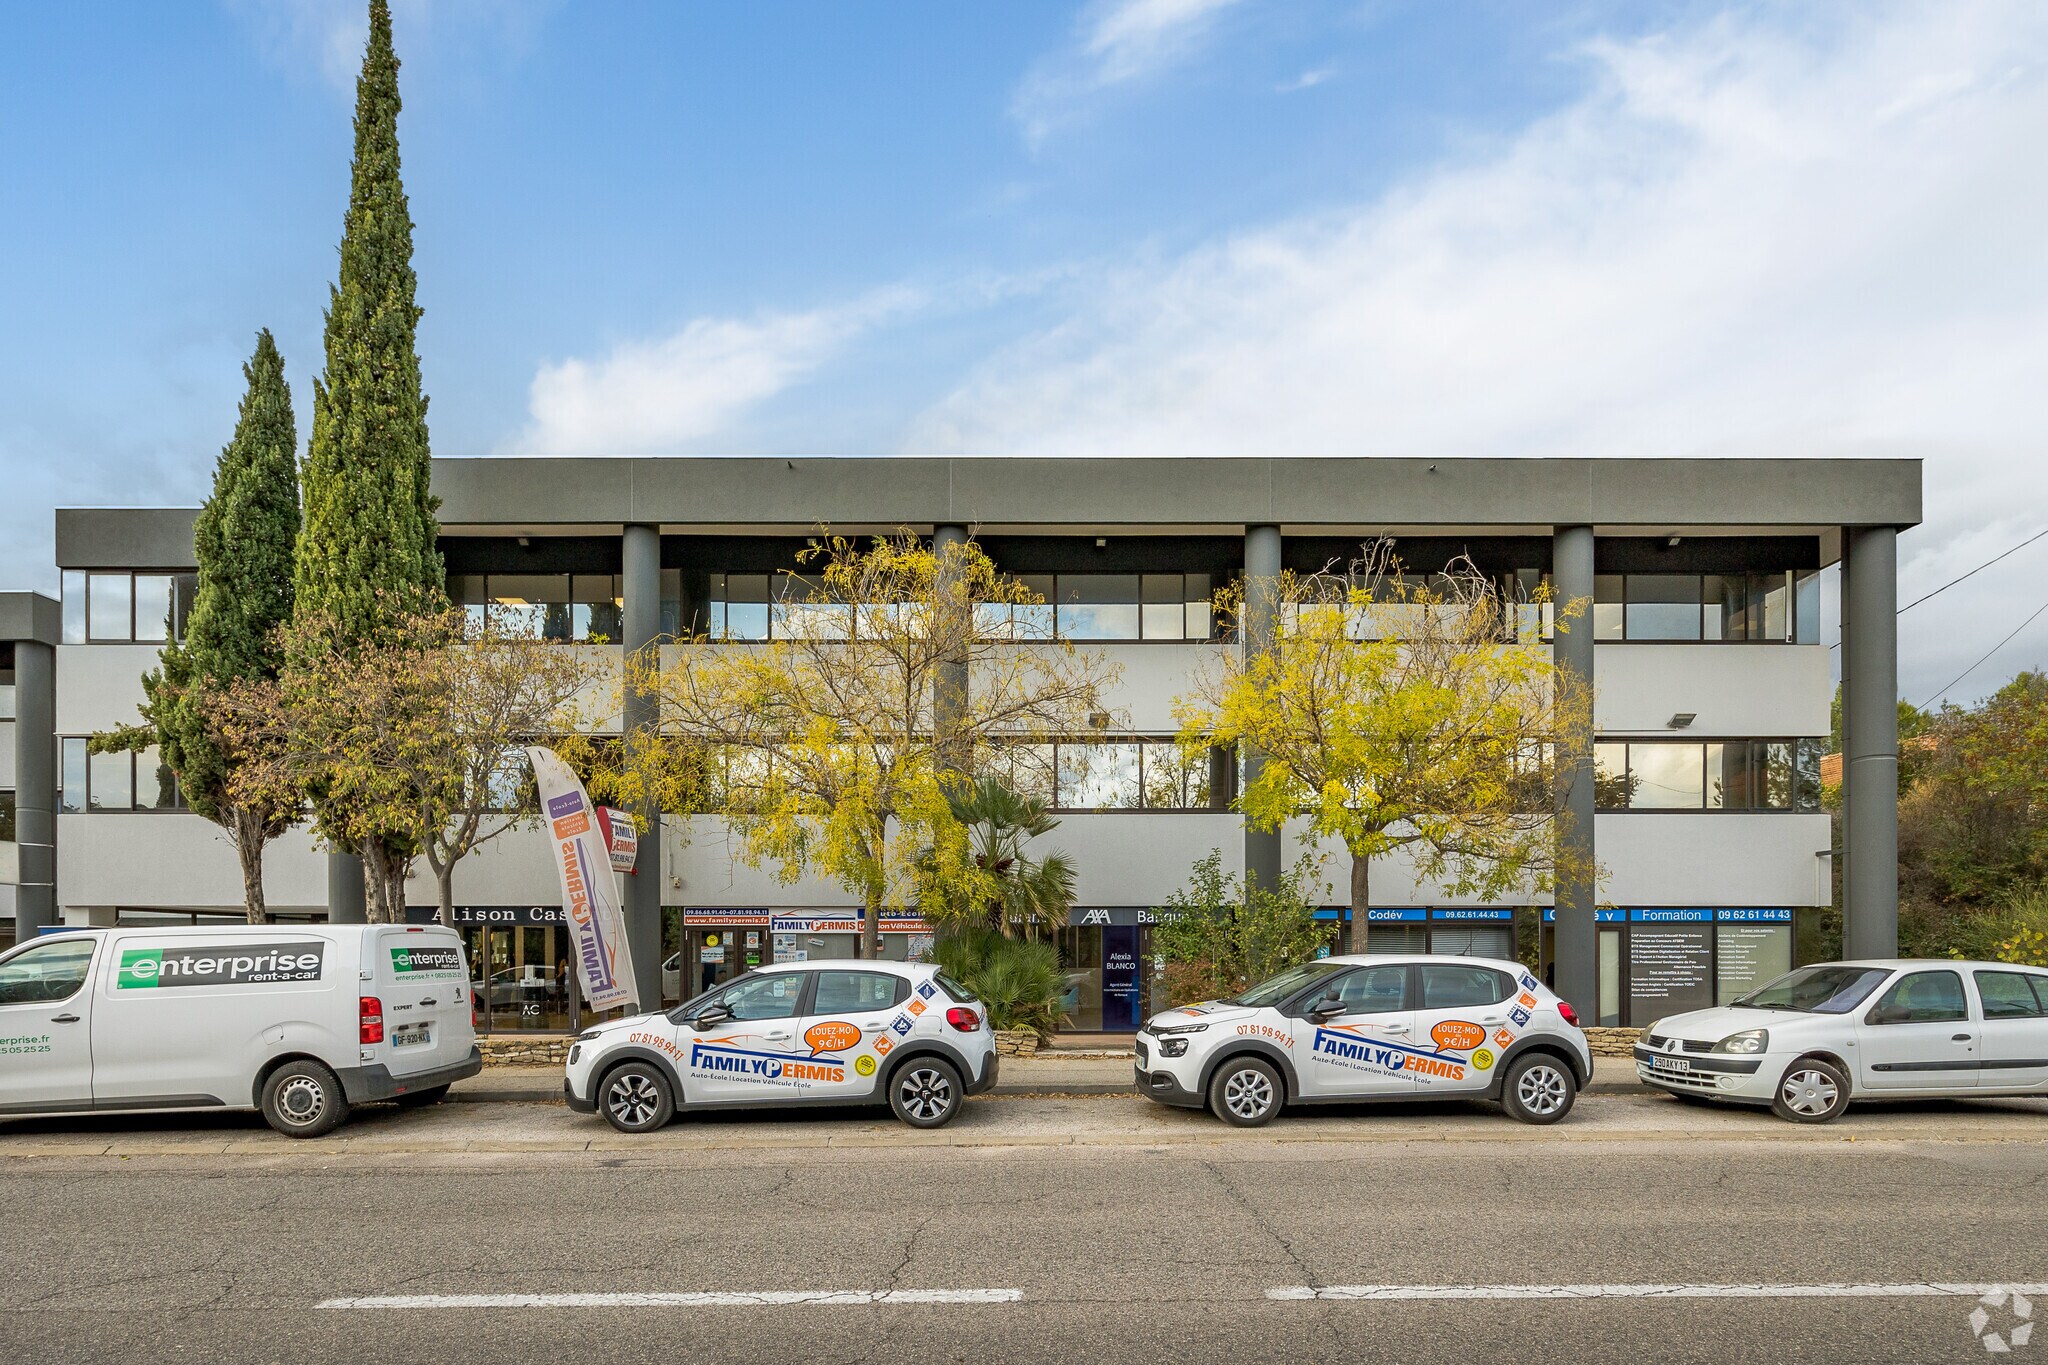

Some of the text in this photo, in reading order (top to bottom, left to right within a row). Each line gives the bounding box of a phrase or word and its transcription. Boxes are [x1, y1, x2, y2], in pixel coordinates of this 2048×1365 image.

[432, 907, 516, 921] Alison
[1081, 909, 1112, 925] AXA
[1368, 910, 1403, 920] Codév
[1445, 911, 1499, 919] 09.62.61.44.43
[1643, 910, 1701, 920] Formation
[131, 949, 320, 979] enterprise
[397, 951, 458, 967] enterprise
[1106, 962, 1136, 970] BLANCO
[248, 971, 318, 981] rent-a-car
[811, 1026, 855, 1036] LOUEZ-MOI
[1236, 1025, 1248, 1035] 07
[1250, 1024, 1260, 1034] 81
[1262, 1025, 1273, 1037] 98
[1274, 1030, 1286, 1042] 94
[1436, 1025, 1480, 1035] LOUEZ-MOI
[630, 1033, 642, 1043] 07
[642, 1033, 652, 1044] 81
[653, 1036, 665, 1049] 98
[664, 1041, 676, 1055] 94
[690, 1072, 732, 1081] Auto-École
[732, 1075, 762, 1084] Location
[762, 1078, 792, 1087] Véhicule
[1353, 1064, 1382, 1075] Location
[1383, 1069, 1412, 1081] Véhicule
